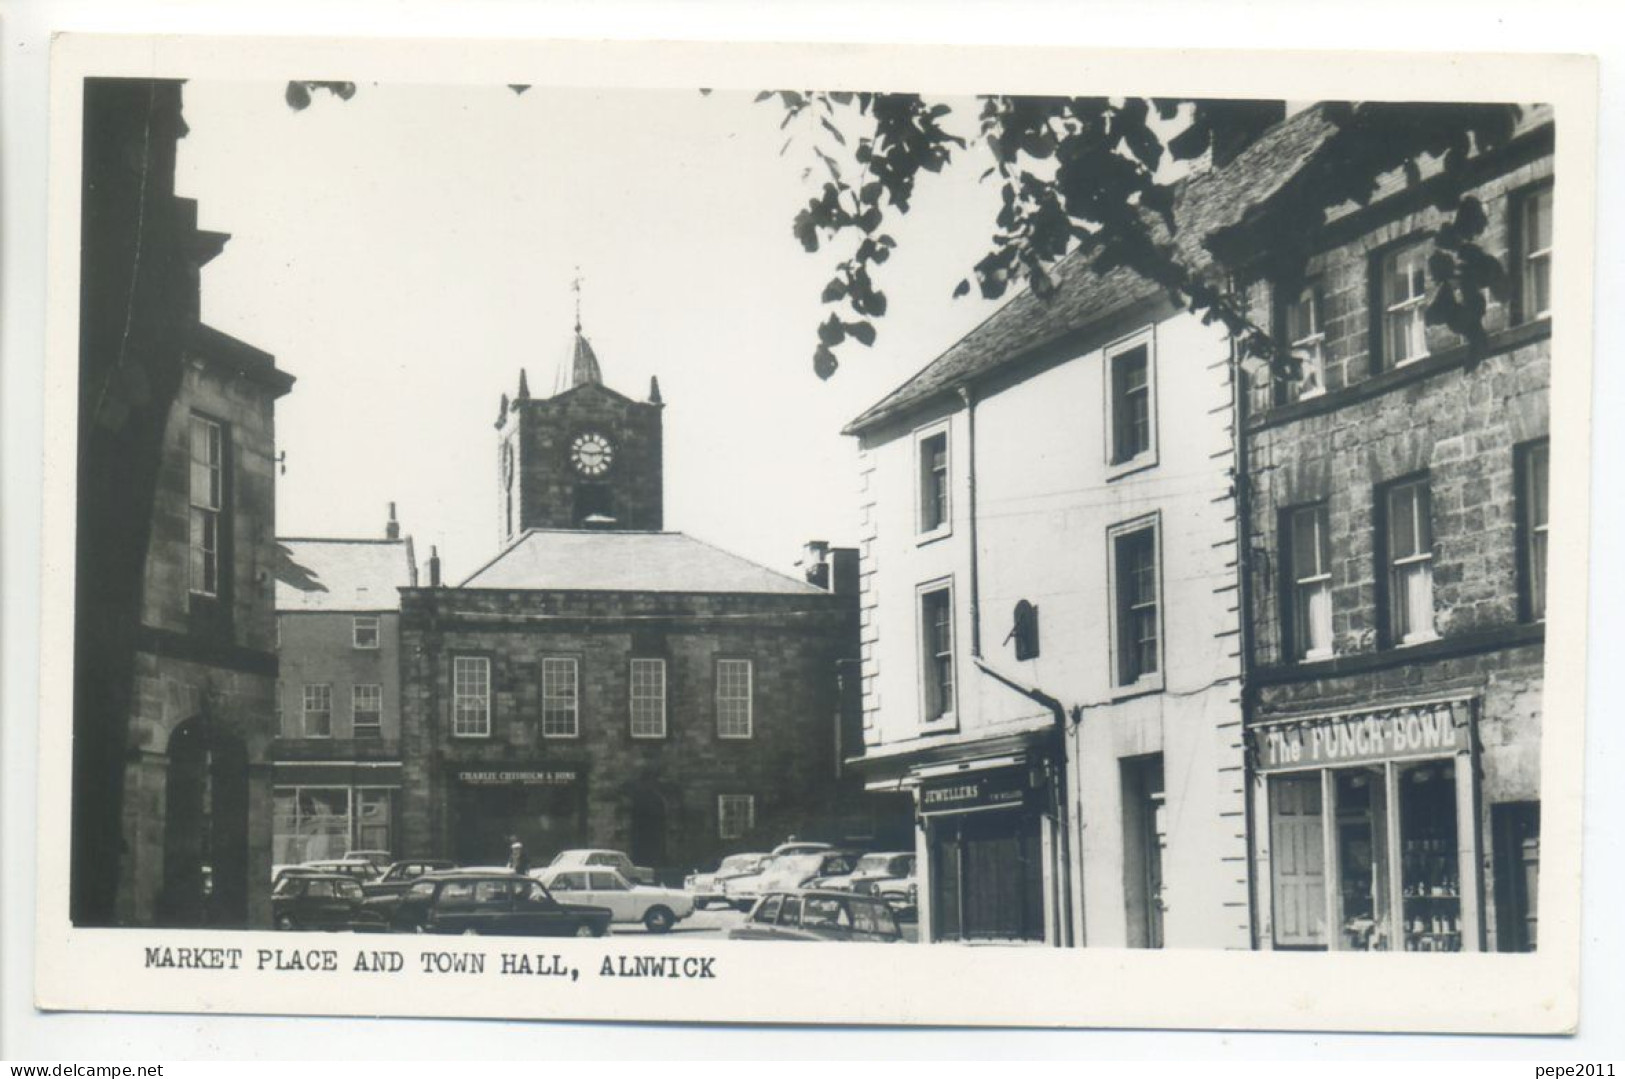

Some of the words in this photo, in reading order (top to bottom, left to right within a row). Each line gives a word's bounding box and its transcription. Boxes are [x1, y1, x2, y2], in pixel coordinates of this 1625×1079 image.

[1268, 730, 1302, 765] The
[1312, 709, 1456, 761] PUNCH-BOWL
[924, 785, 978, 803] JEWELLERS
